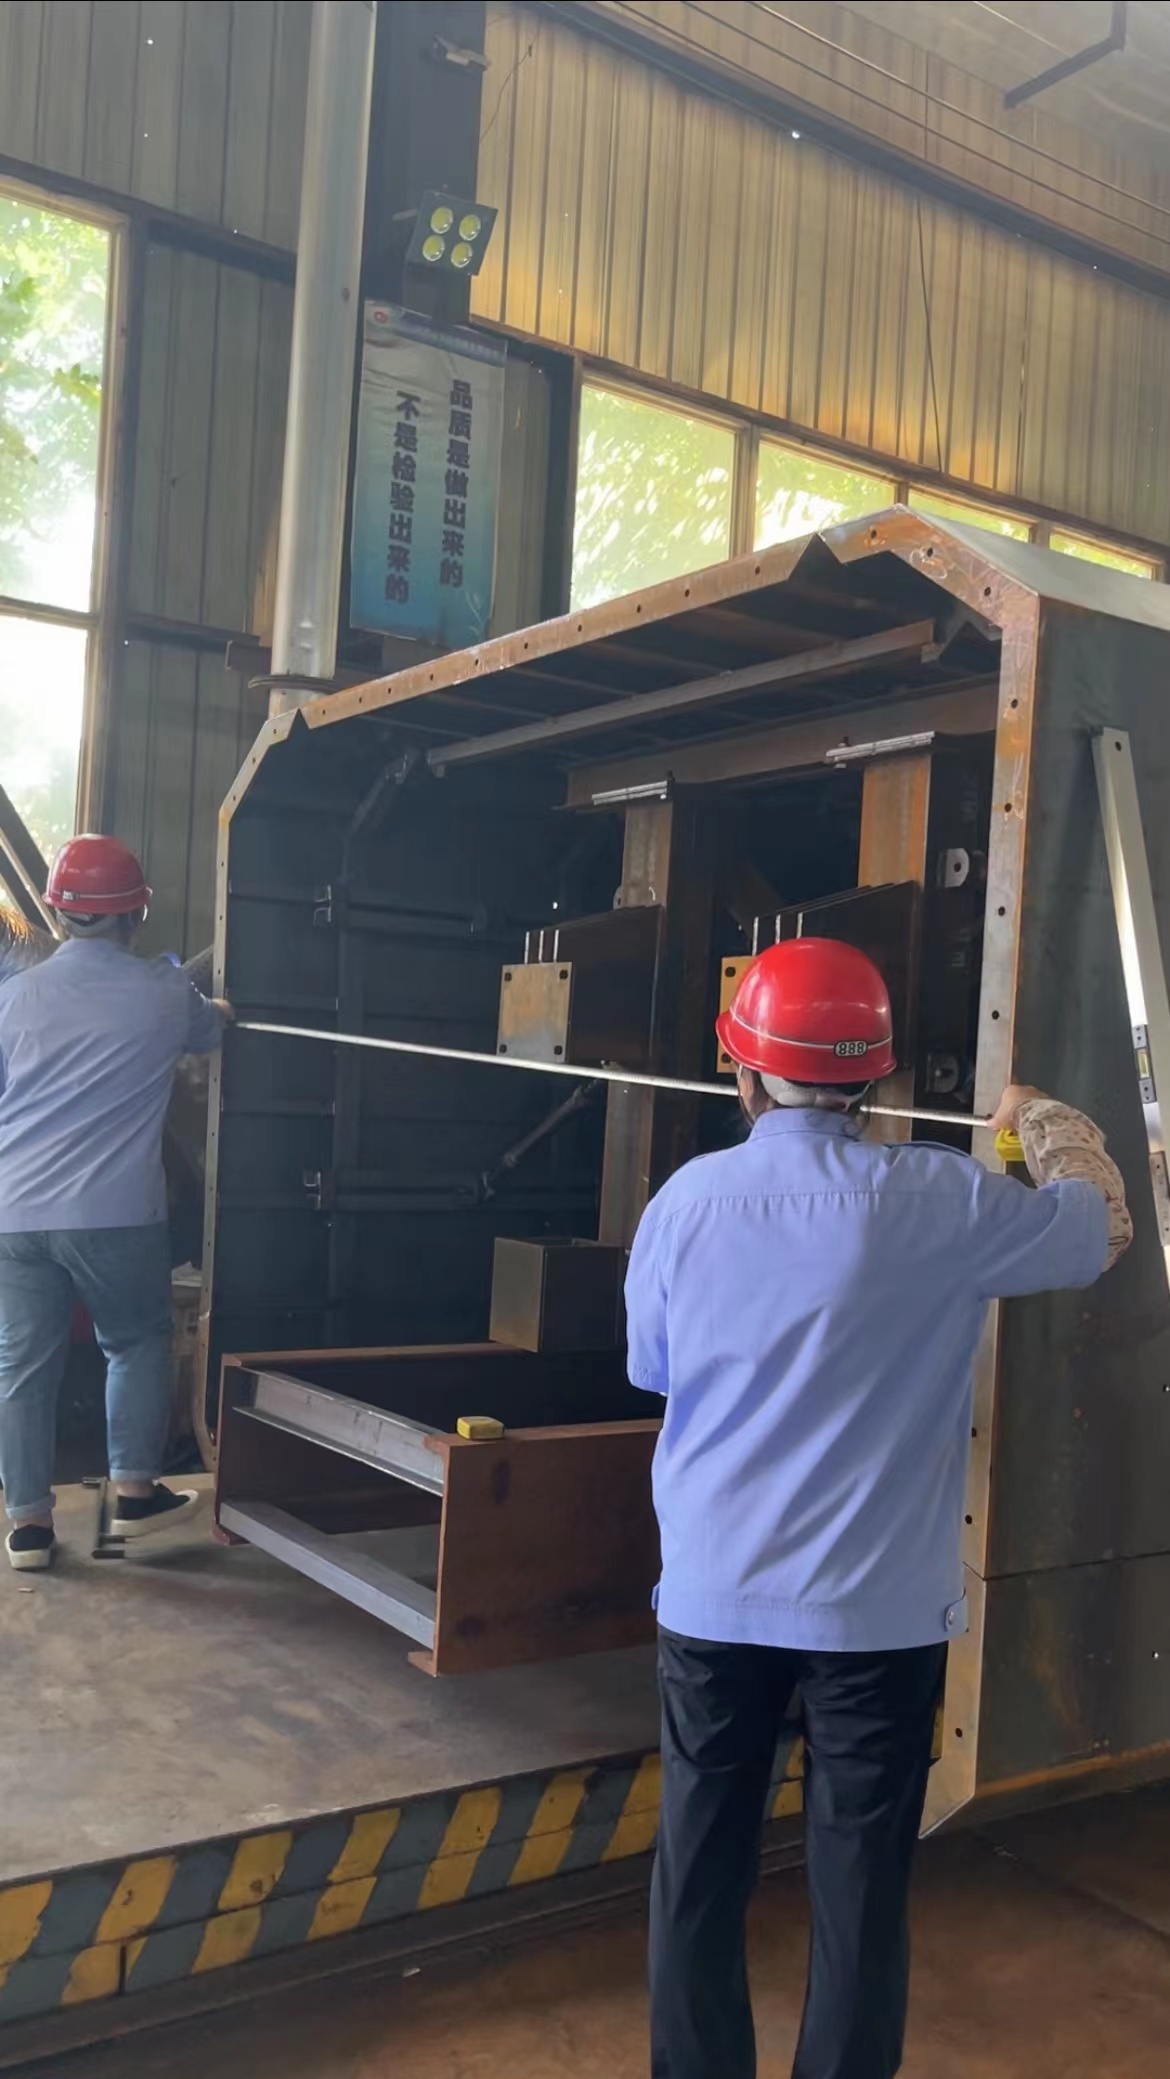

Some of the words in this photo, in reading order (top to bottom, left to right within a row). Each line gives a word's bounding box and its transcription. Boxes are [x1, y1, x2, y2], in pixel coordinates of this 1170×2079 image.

[385, 390, 421, 604] 不是检验出来的
